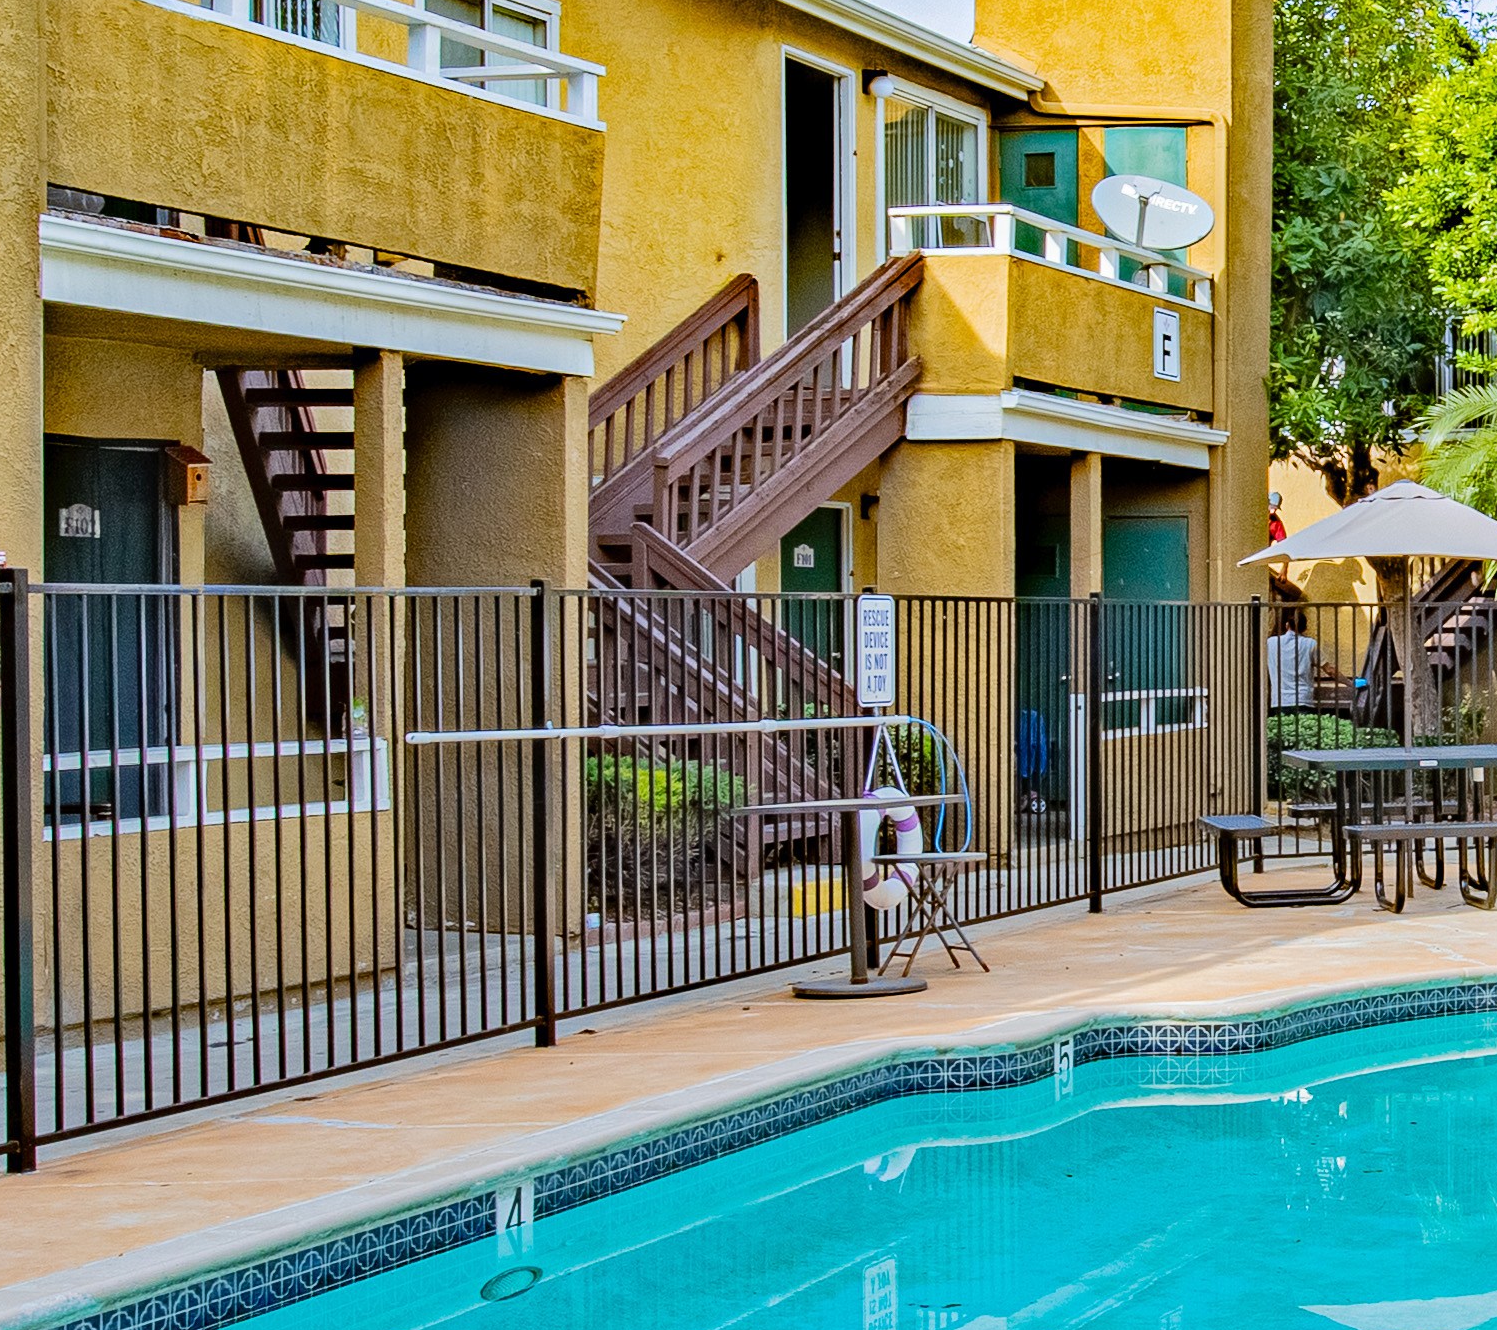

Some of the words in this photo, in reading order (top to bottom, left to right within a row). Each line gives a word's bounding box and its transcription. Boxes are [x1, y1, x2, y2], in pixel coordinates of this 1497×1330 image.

[1162, 334, 1172, 372] F
[863, 609, 889, 626] RESCUE
[864, 631, 889, 648] DEVICE
[865, 653, 872, 670] IS
[874, 653, 888, 670] NOT
[867, 675, 872, 692] A
[874, 675, 887, 692] TOY
[1058, 1039, 1070, 1073] 5
[505, 1187, 526, 1229] 4
